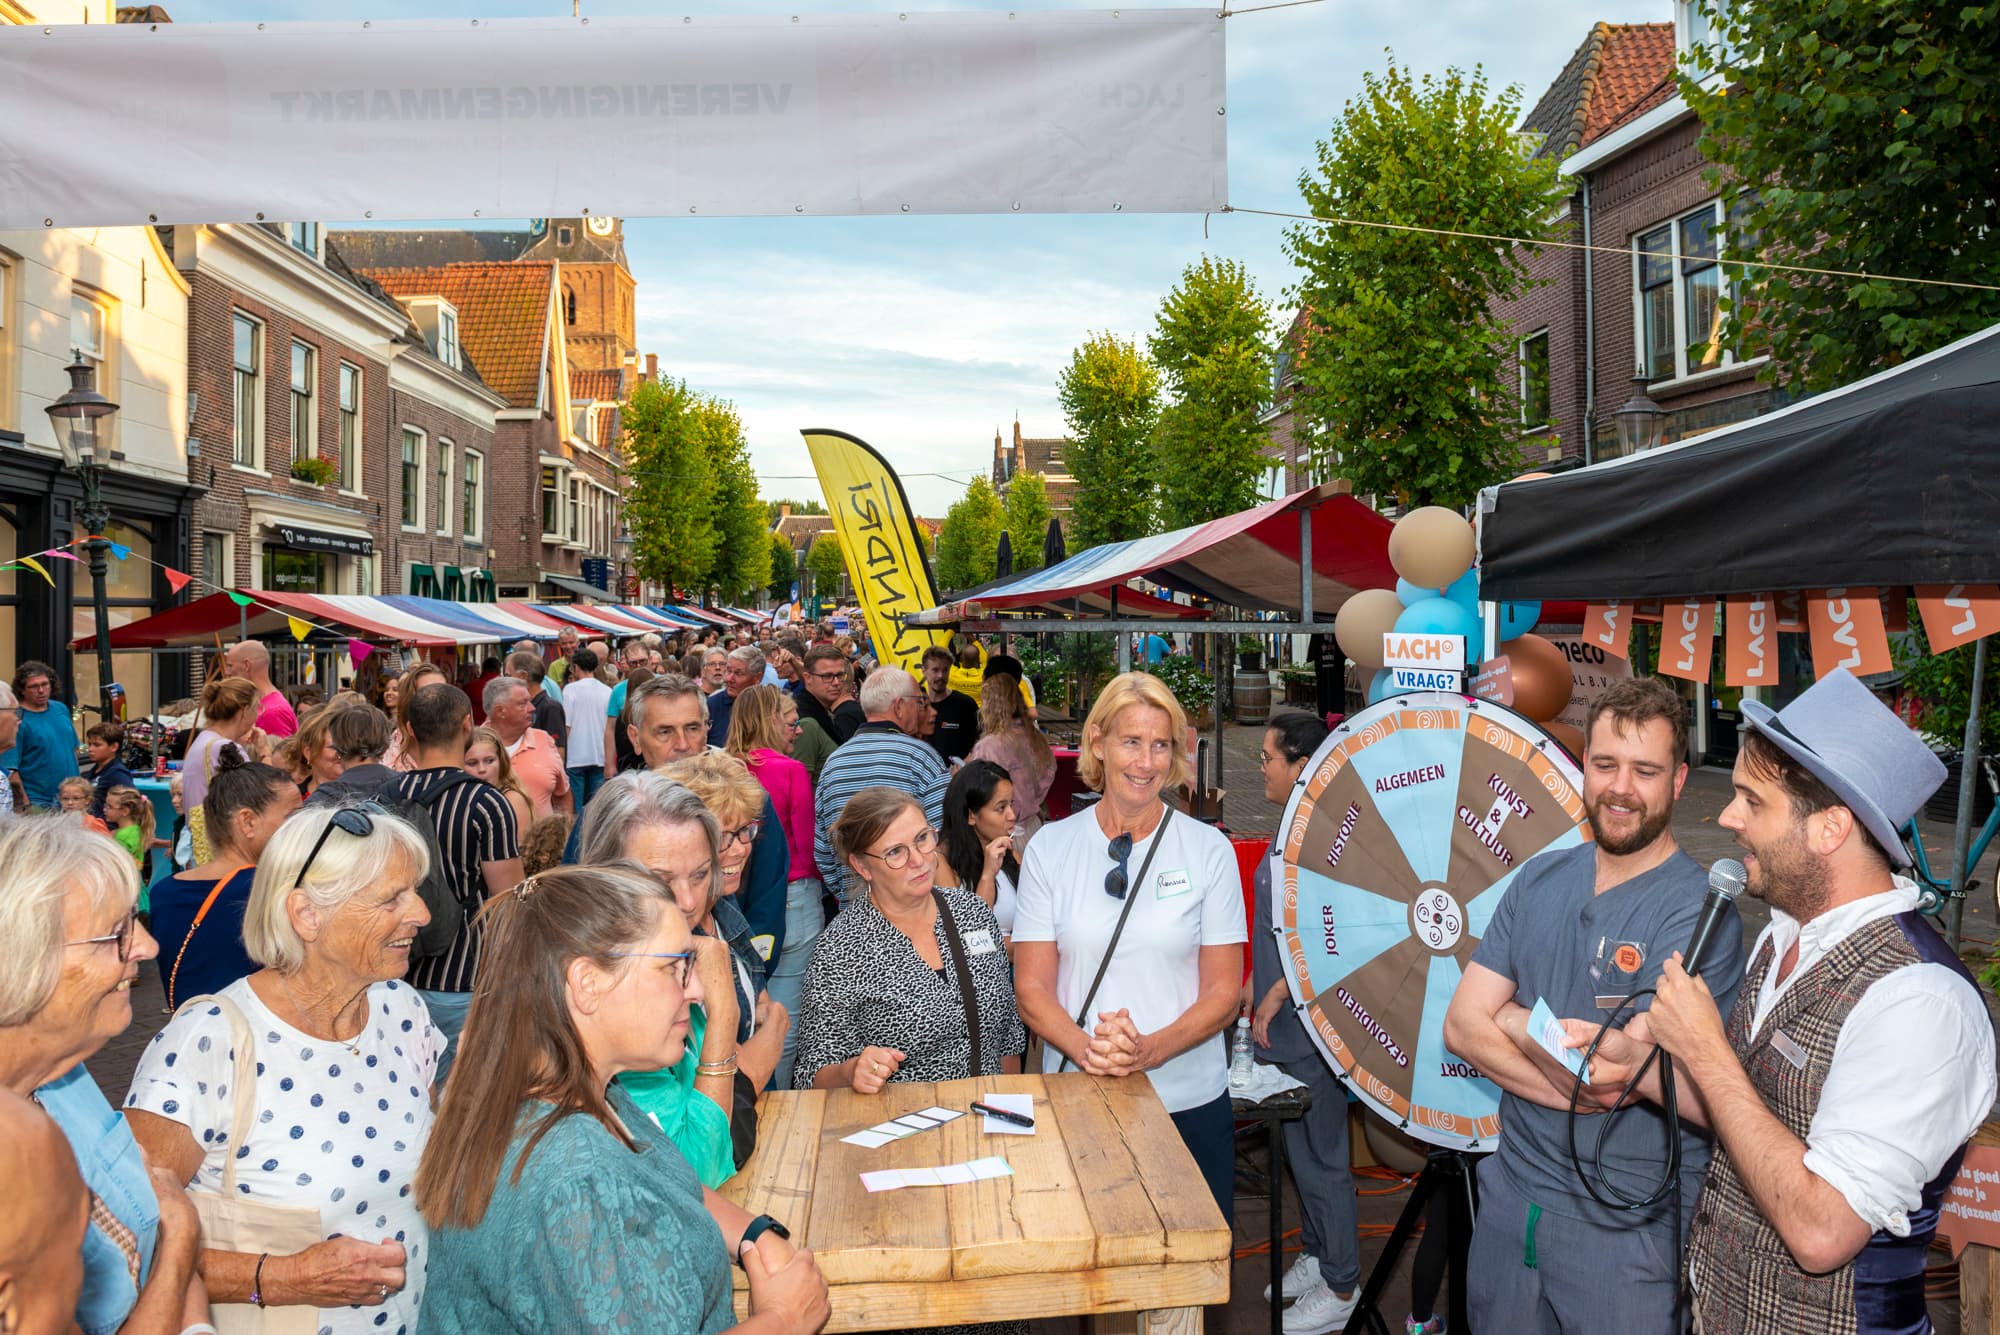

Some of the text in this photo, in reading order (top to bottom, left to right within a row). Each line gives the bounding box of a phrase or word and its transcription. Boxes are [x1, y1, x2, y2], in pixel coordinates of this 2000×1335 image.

[1386, 638, 1441, 661] LACH
[1396, 671, 1455, 690] VRAAG?
[1374, 763, 1446, 794] ALGEMEEN
[1486, 772, 1535, 821] KUNST
[1325, 799, 1363, 868] HISTORIE
[1456, 804, 1515, 868] CULTUUR
[1489, 807, 1502, 825] &
[1321, 903, 1340, 956] JOKER
[1335, 986, 1410, 1069] GEZONDHEID
